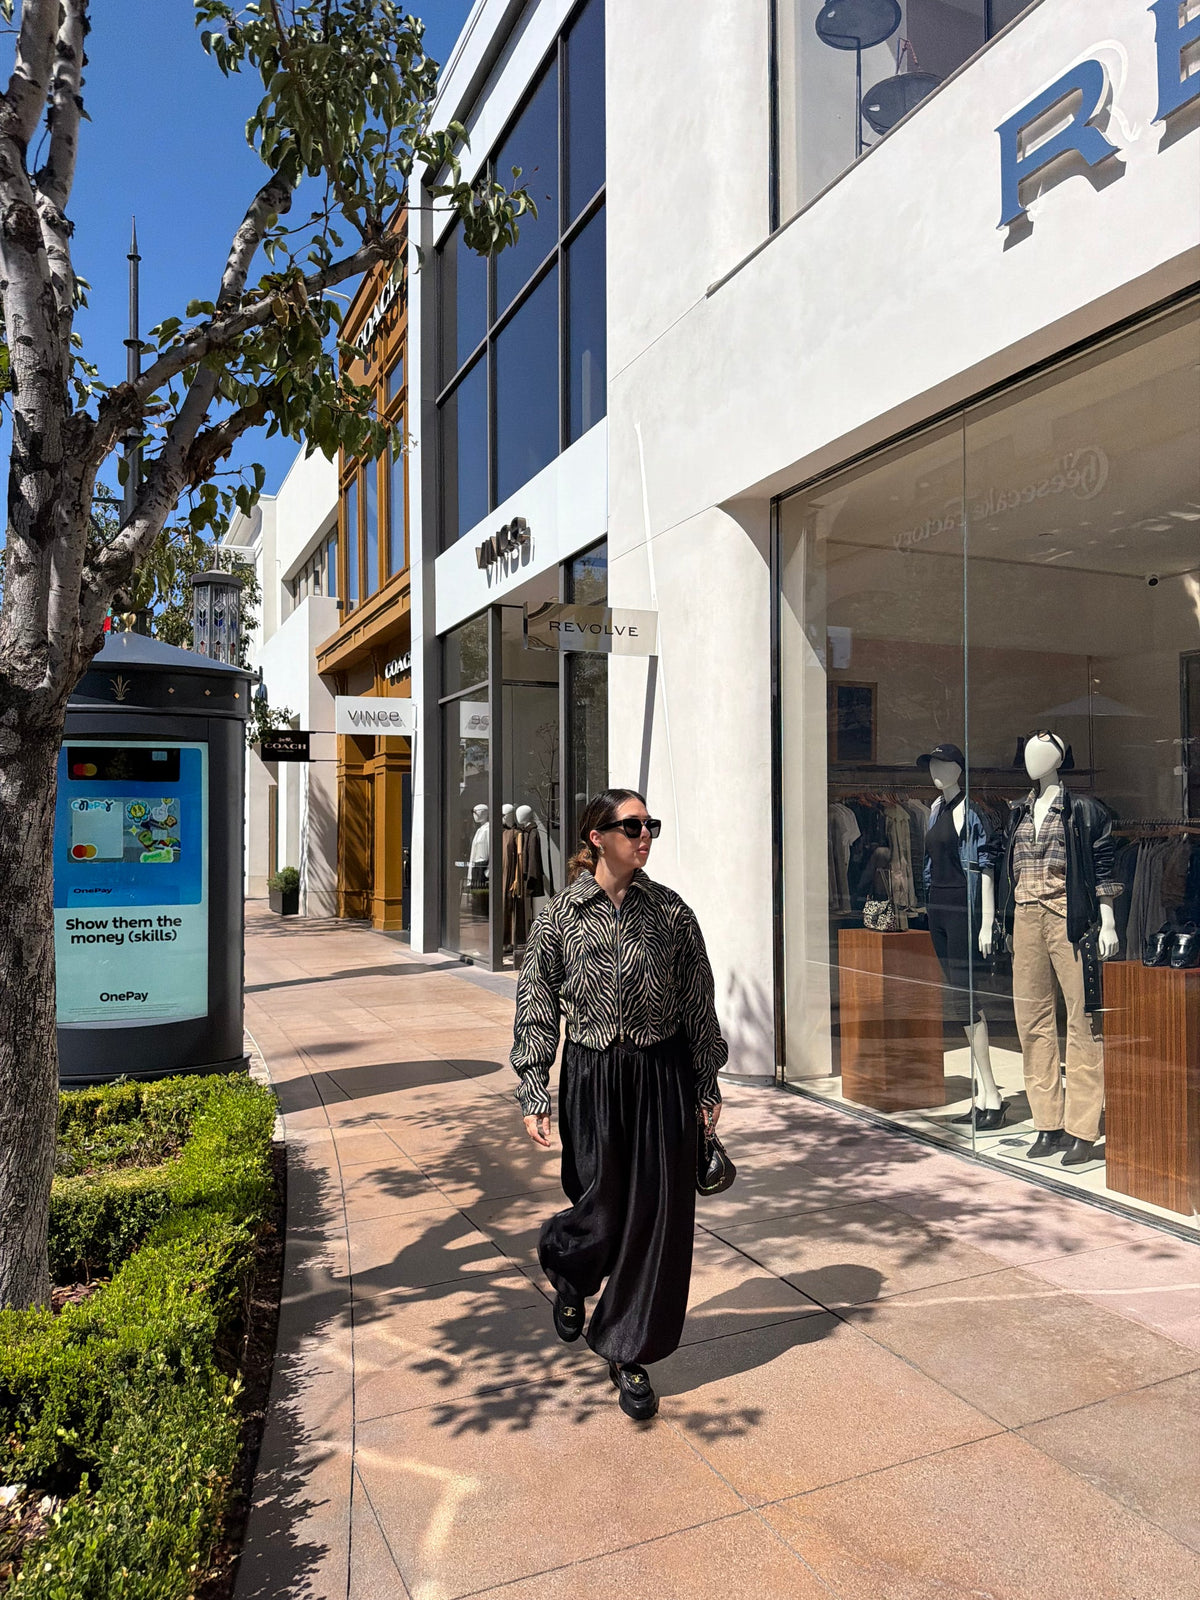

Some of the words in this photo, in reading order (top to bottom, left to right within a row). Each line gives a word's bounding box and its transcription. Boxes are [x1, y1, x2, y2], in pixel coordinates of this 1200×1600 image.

[549, 620, 639, 637] REVOLVE
[385, 650, 411, 679] COAC
[264, 742, 306, 750] COACH
[73, 887, 113, 895] OnePay
[65, 918, 109, 930] Show
[112, 916, 152, 929] them
[157, 915, 182, 928] the
[71, 933, 125, 946] money
[128, 929, 178, 943] (skills)
[99, 991, 149, 1003] OnePay
